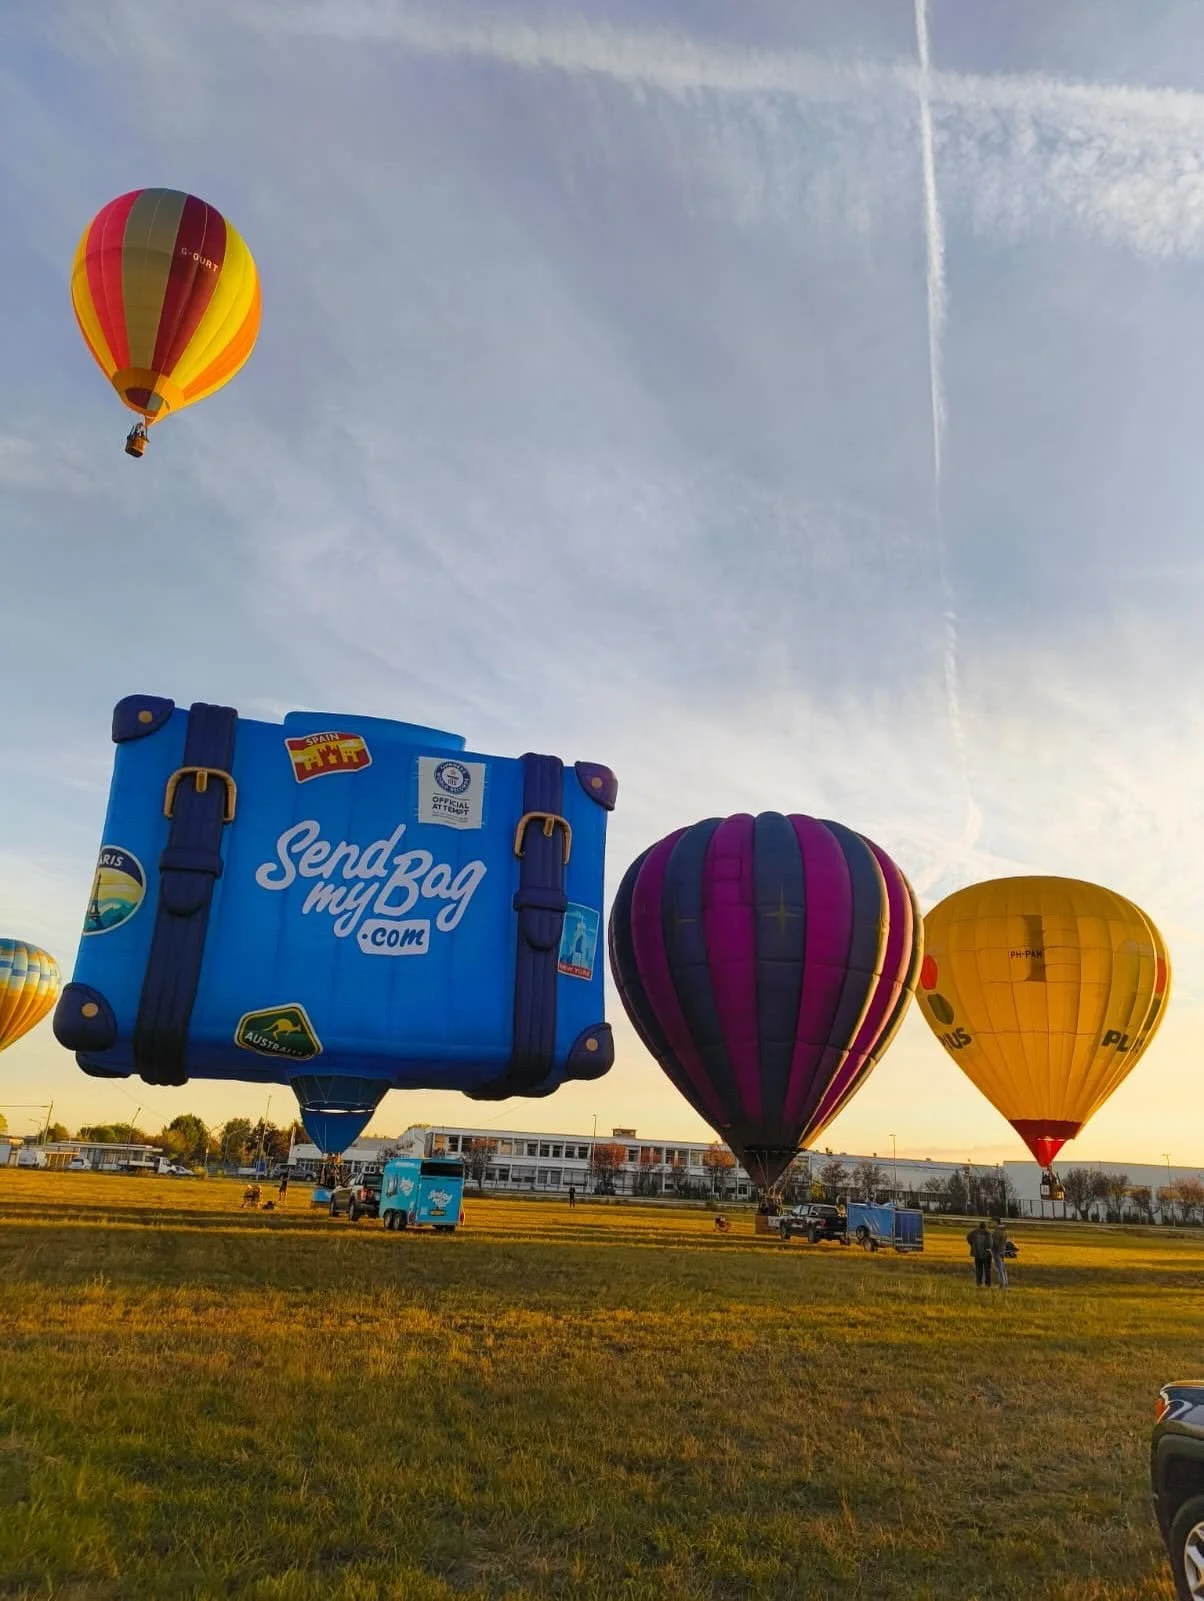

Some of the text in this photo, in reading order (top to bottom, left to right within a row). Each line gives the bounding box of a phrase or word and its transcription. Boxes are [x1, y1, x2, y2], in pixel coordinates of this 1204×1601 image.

[305, 733, 340, 746] SPAIN
[432, 796, 470, 809] OFFICIAL
[432, 803, 470, 816] ATTEMPT
[98, 854, 124, 867] ARIS
[255, 819, 407, 891] Send
[302, 849, 488, 938] my Bag
[361, 927, 426, 948] .com
